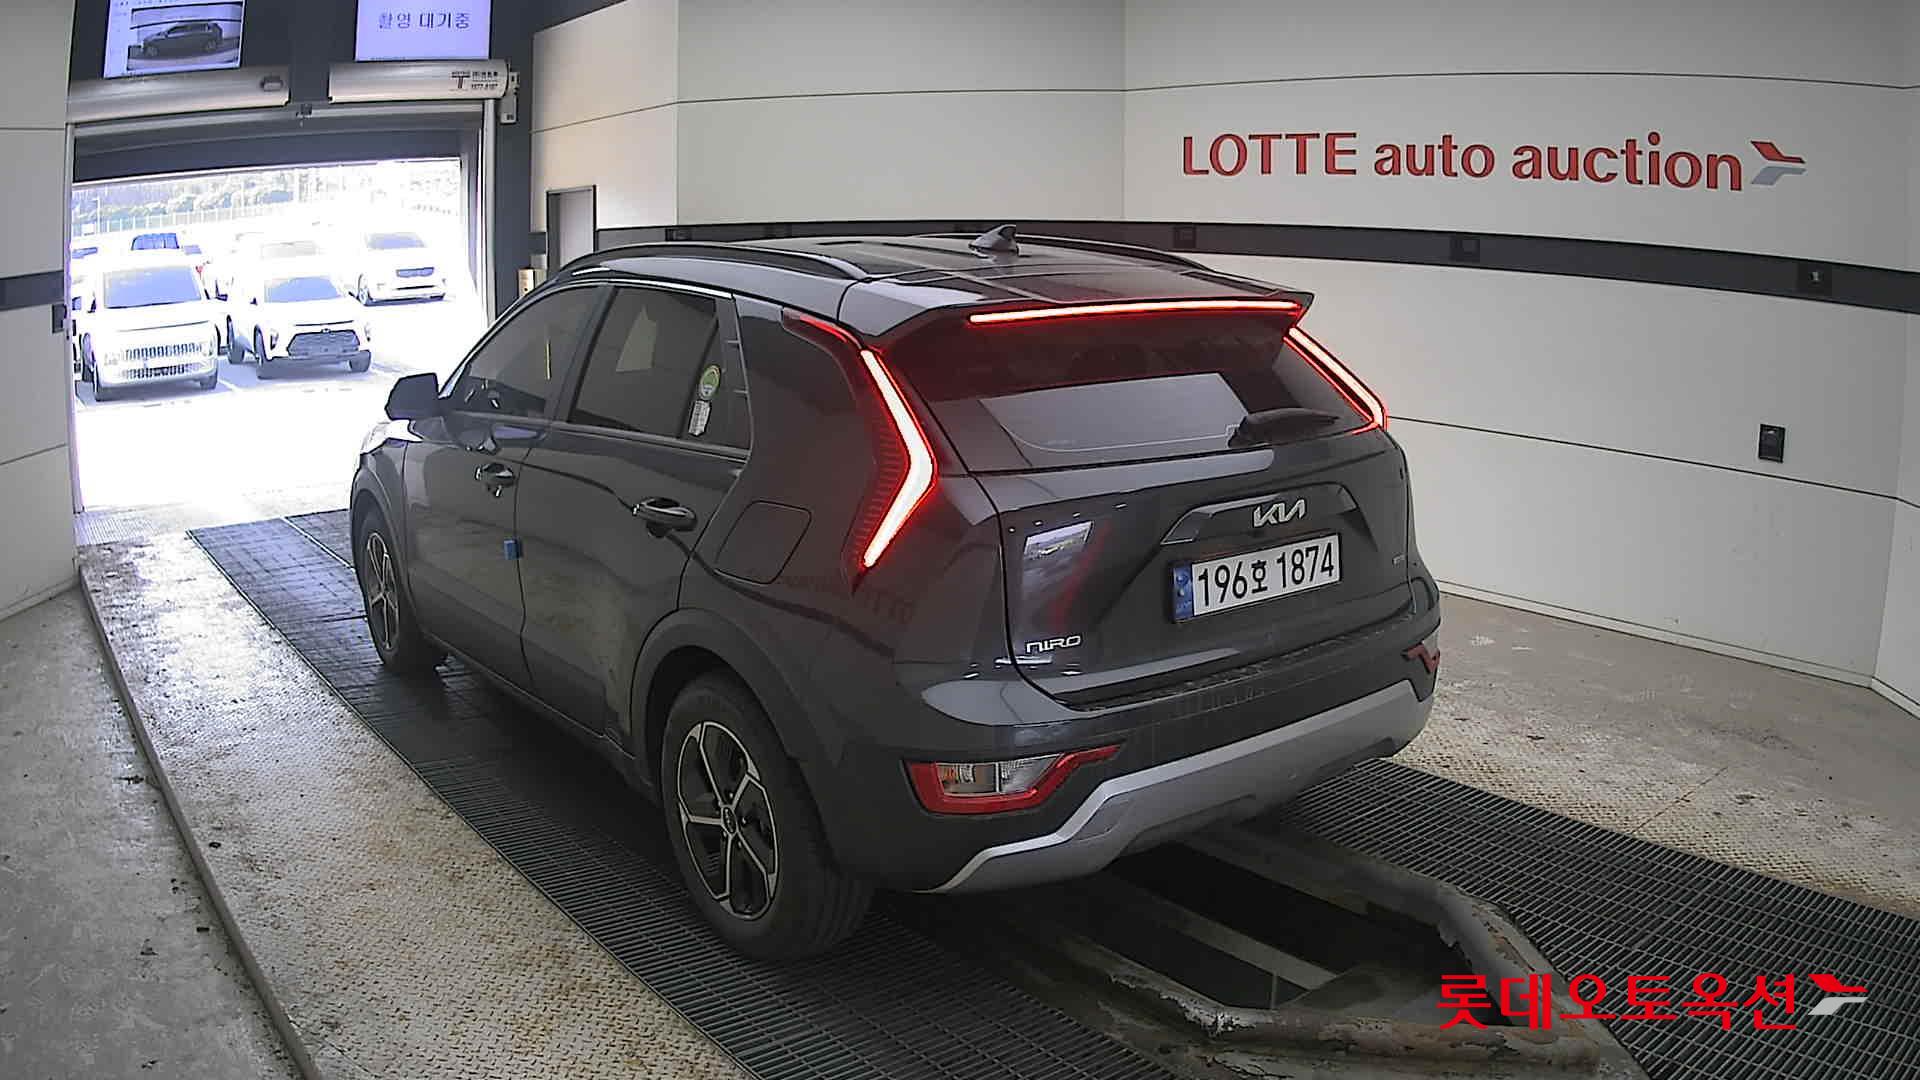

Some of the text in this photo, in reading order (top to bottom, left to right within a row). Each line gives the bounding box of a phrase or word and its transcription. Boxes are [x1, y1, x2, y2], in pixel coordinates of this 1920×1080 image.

[419, 12, 469, 29] 대기중
[1183, 132, 1743, 191] LOTTE auto auction
[1253, 498, 1306, 528] KIA
[1198, 542, 1335, 607] 196호 1874
[1026, 635, 1081, 653] NIRO
